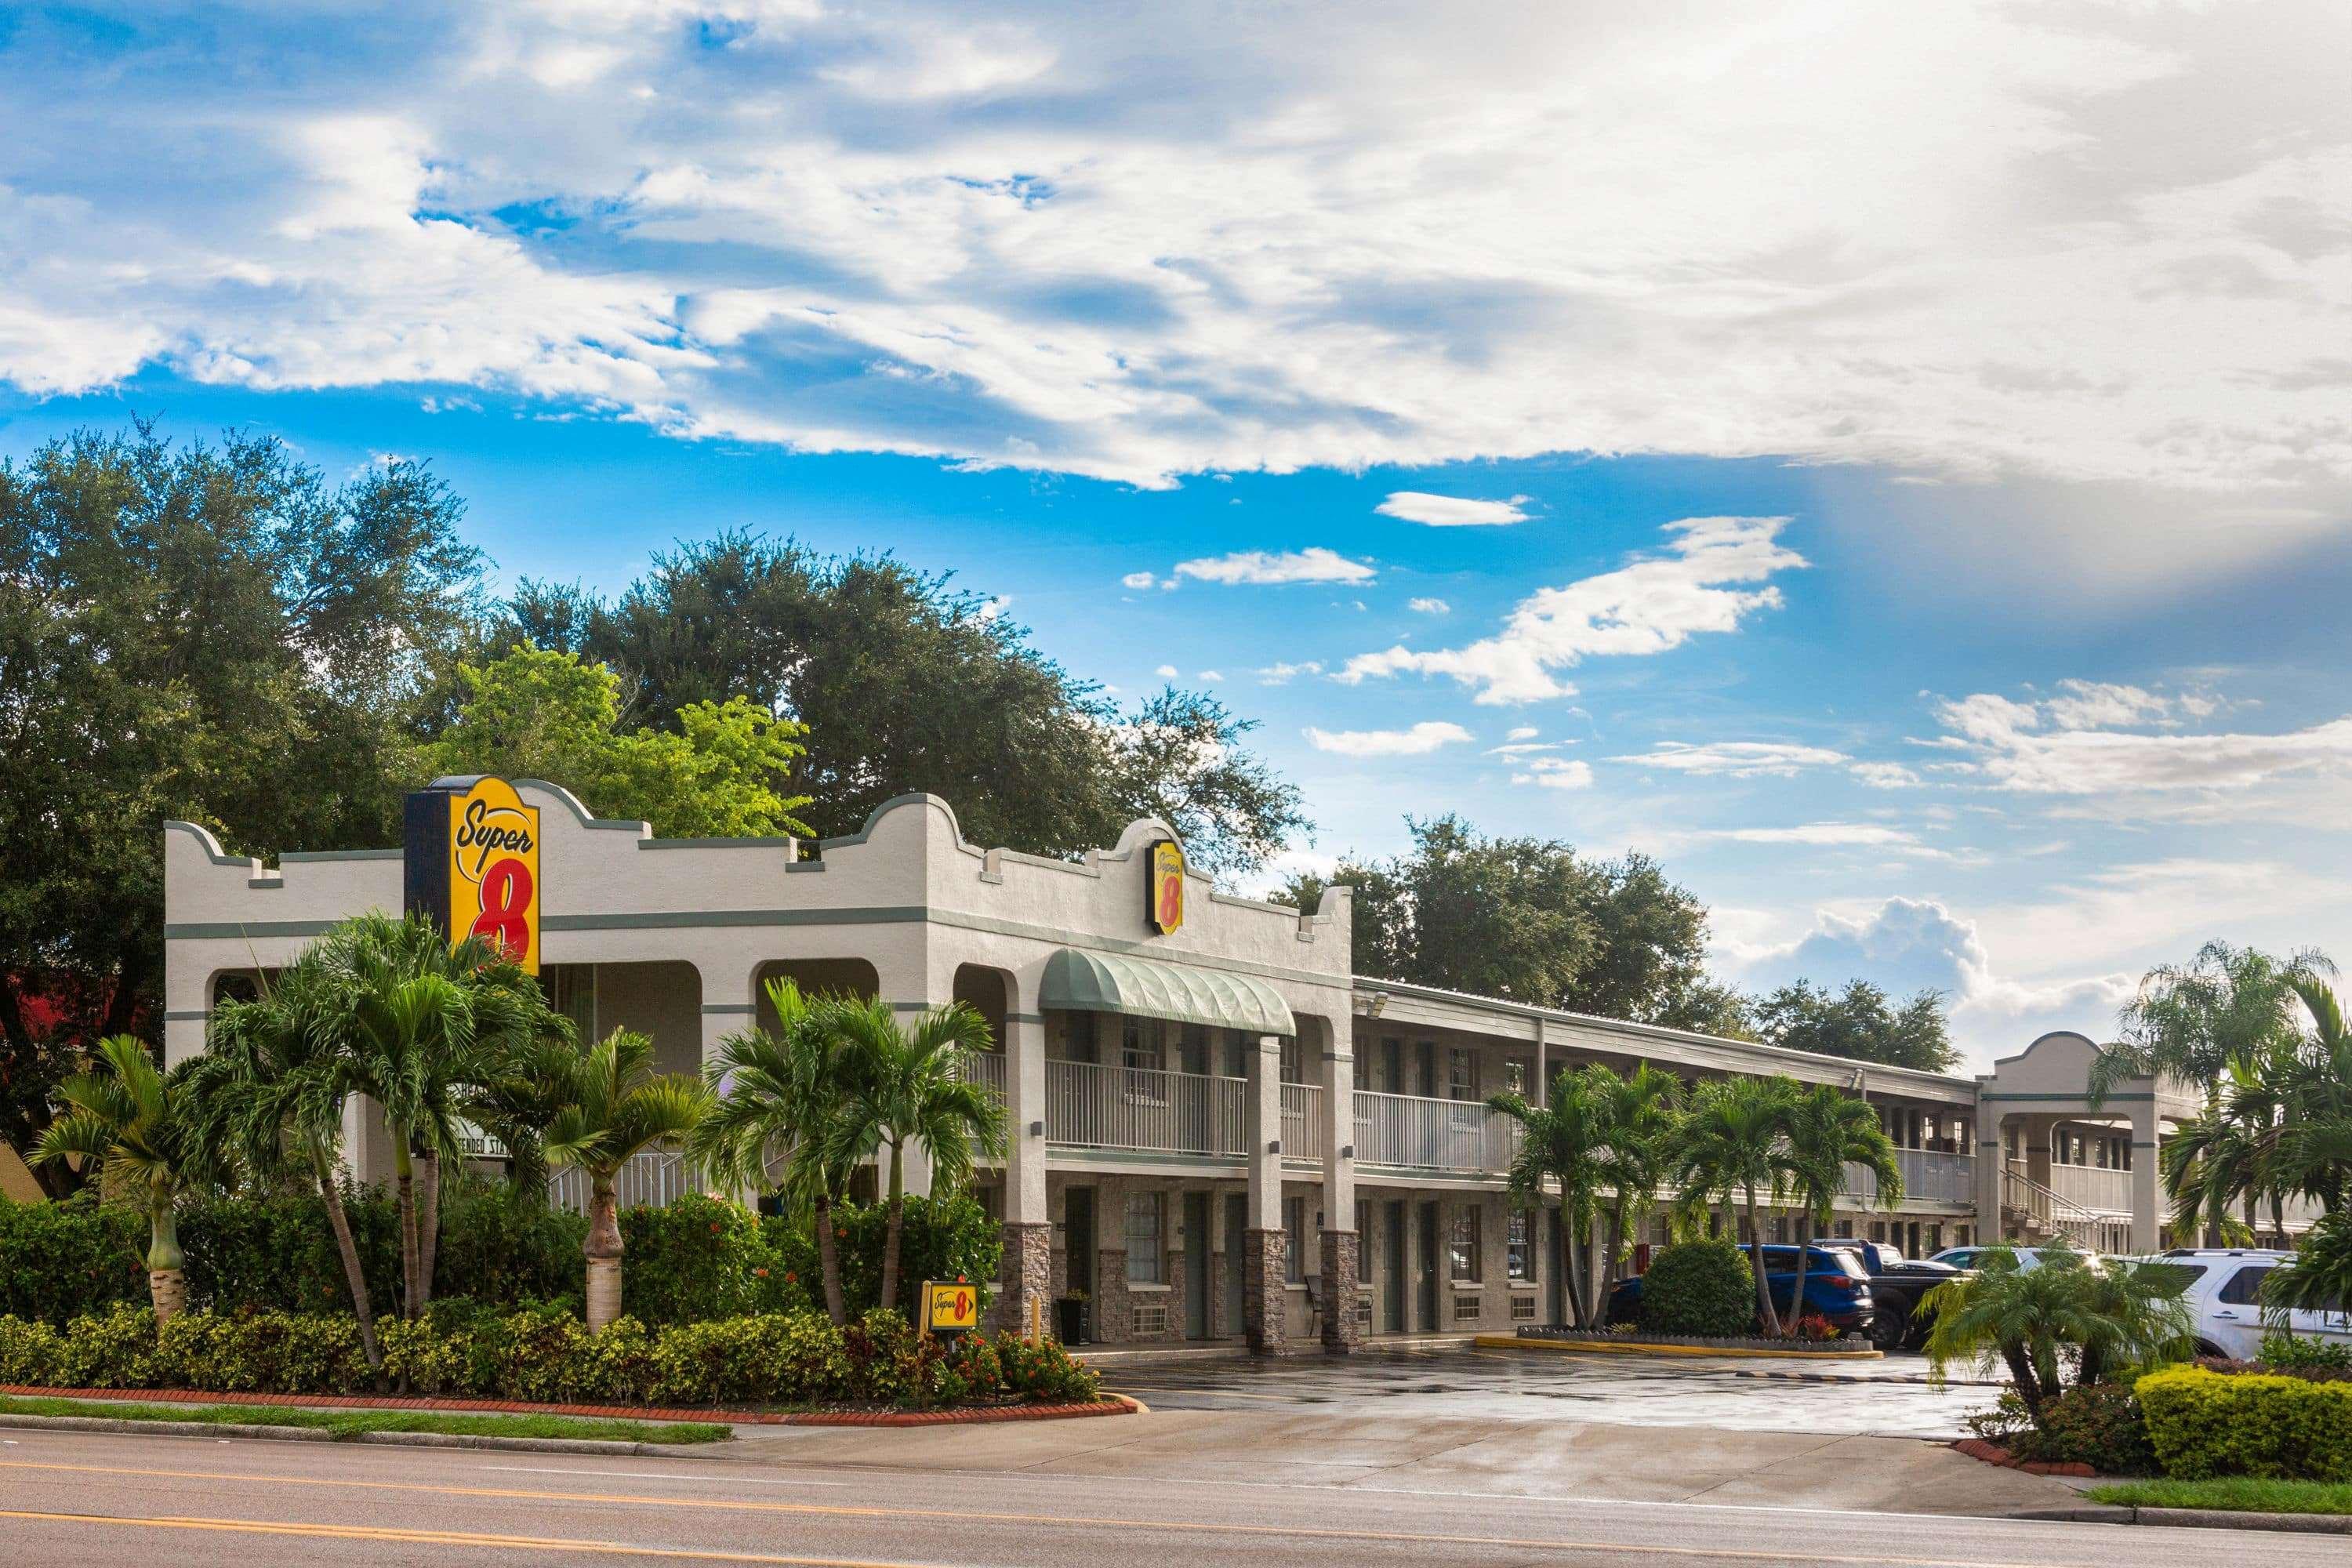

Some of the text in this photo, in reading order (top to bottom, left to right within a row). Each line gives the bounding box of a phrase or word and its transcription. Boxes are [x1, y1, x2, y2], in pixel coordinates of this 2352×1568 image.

[456, 799, 534, 875] Super
[1156, 851, 1180, 883] Super
[470, 858, 534, 971] 8
[1160, 876, 1180, 927] 8
[935, 1290, 967, 1322] Super 8
